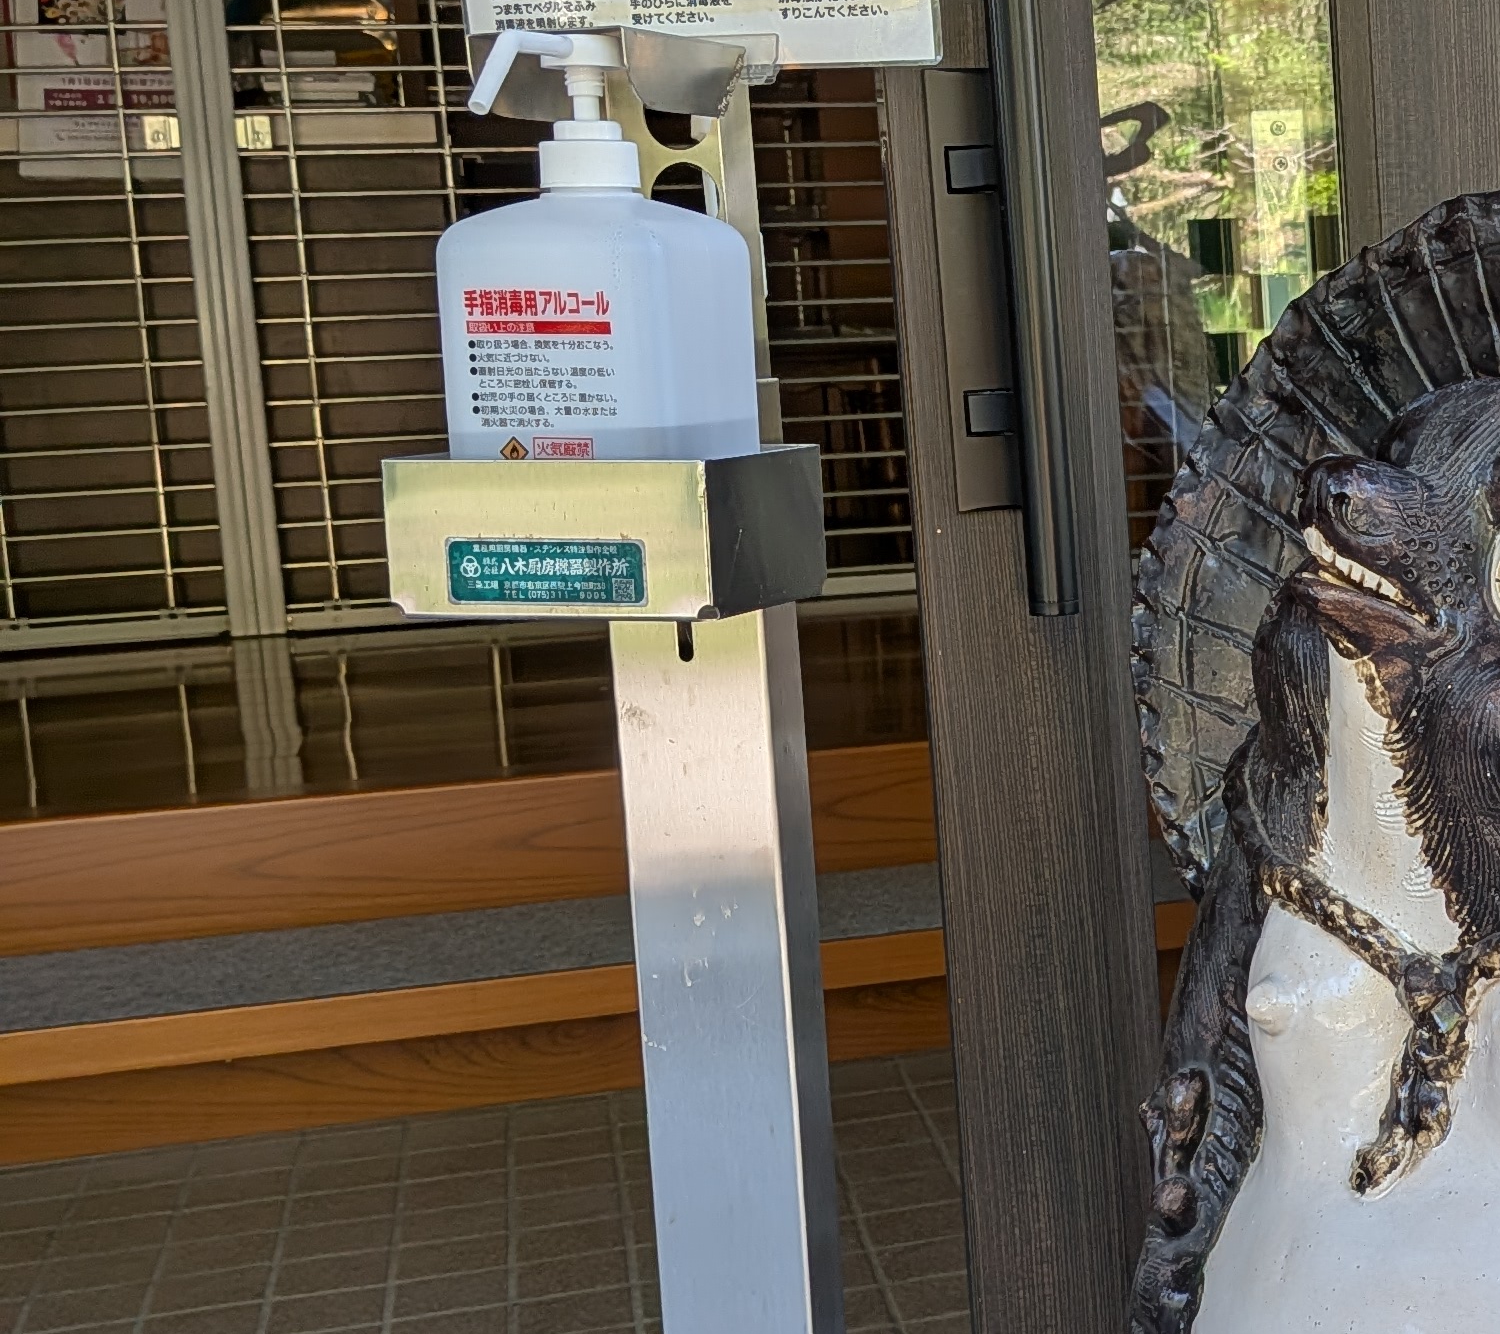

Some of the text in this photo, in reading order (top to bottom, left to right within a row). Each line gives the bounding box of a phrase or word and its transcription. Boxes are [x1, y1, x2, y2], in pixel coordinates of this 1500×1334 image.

[632, 10, 715, 26] 受けてください。
[779, 3, 889, 19] すりこんでください。
[463, 289, 610, 316] 手指消毒用アルコール
[537, 441, 590, 458] 火気厳禁
[500, 556, 629, 577] 八木厨房機器製作所
